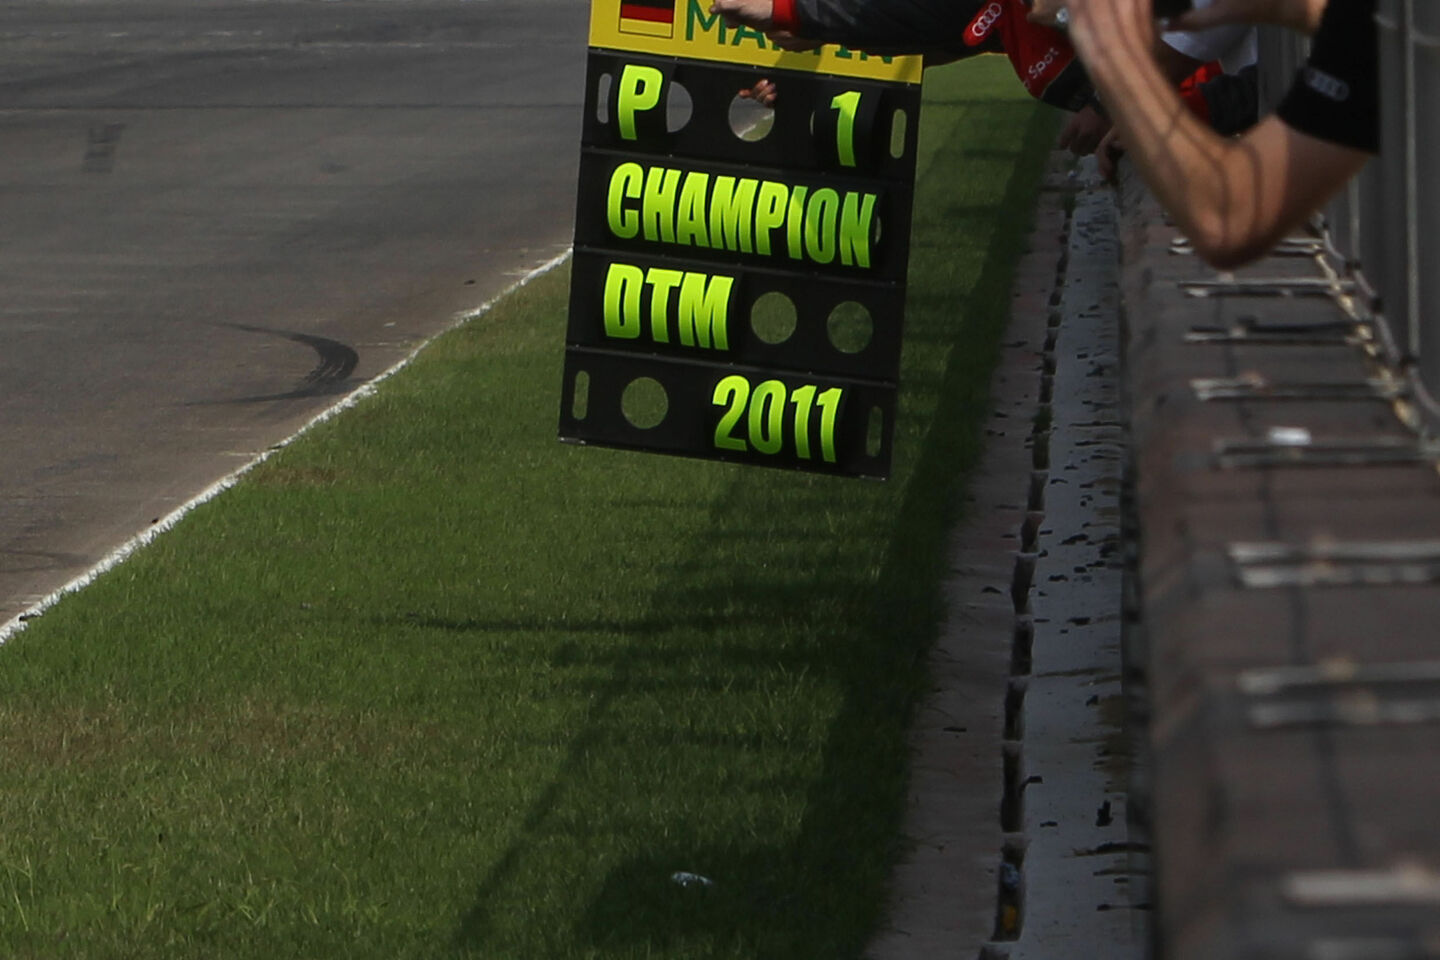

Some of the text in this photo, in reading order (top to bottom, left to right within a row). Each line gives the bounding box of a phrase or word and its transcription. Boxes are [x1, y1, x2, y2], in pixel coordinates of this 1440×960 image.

[617, 64, 862, 167] P 1
[607, 162, 877, 269] CHAMPION
[603, 263, 734, 351] DTM
[711, 374, 843, 463] 2011
